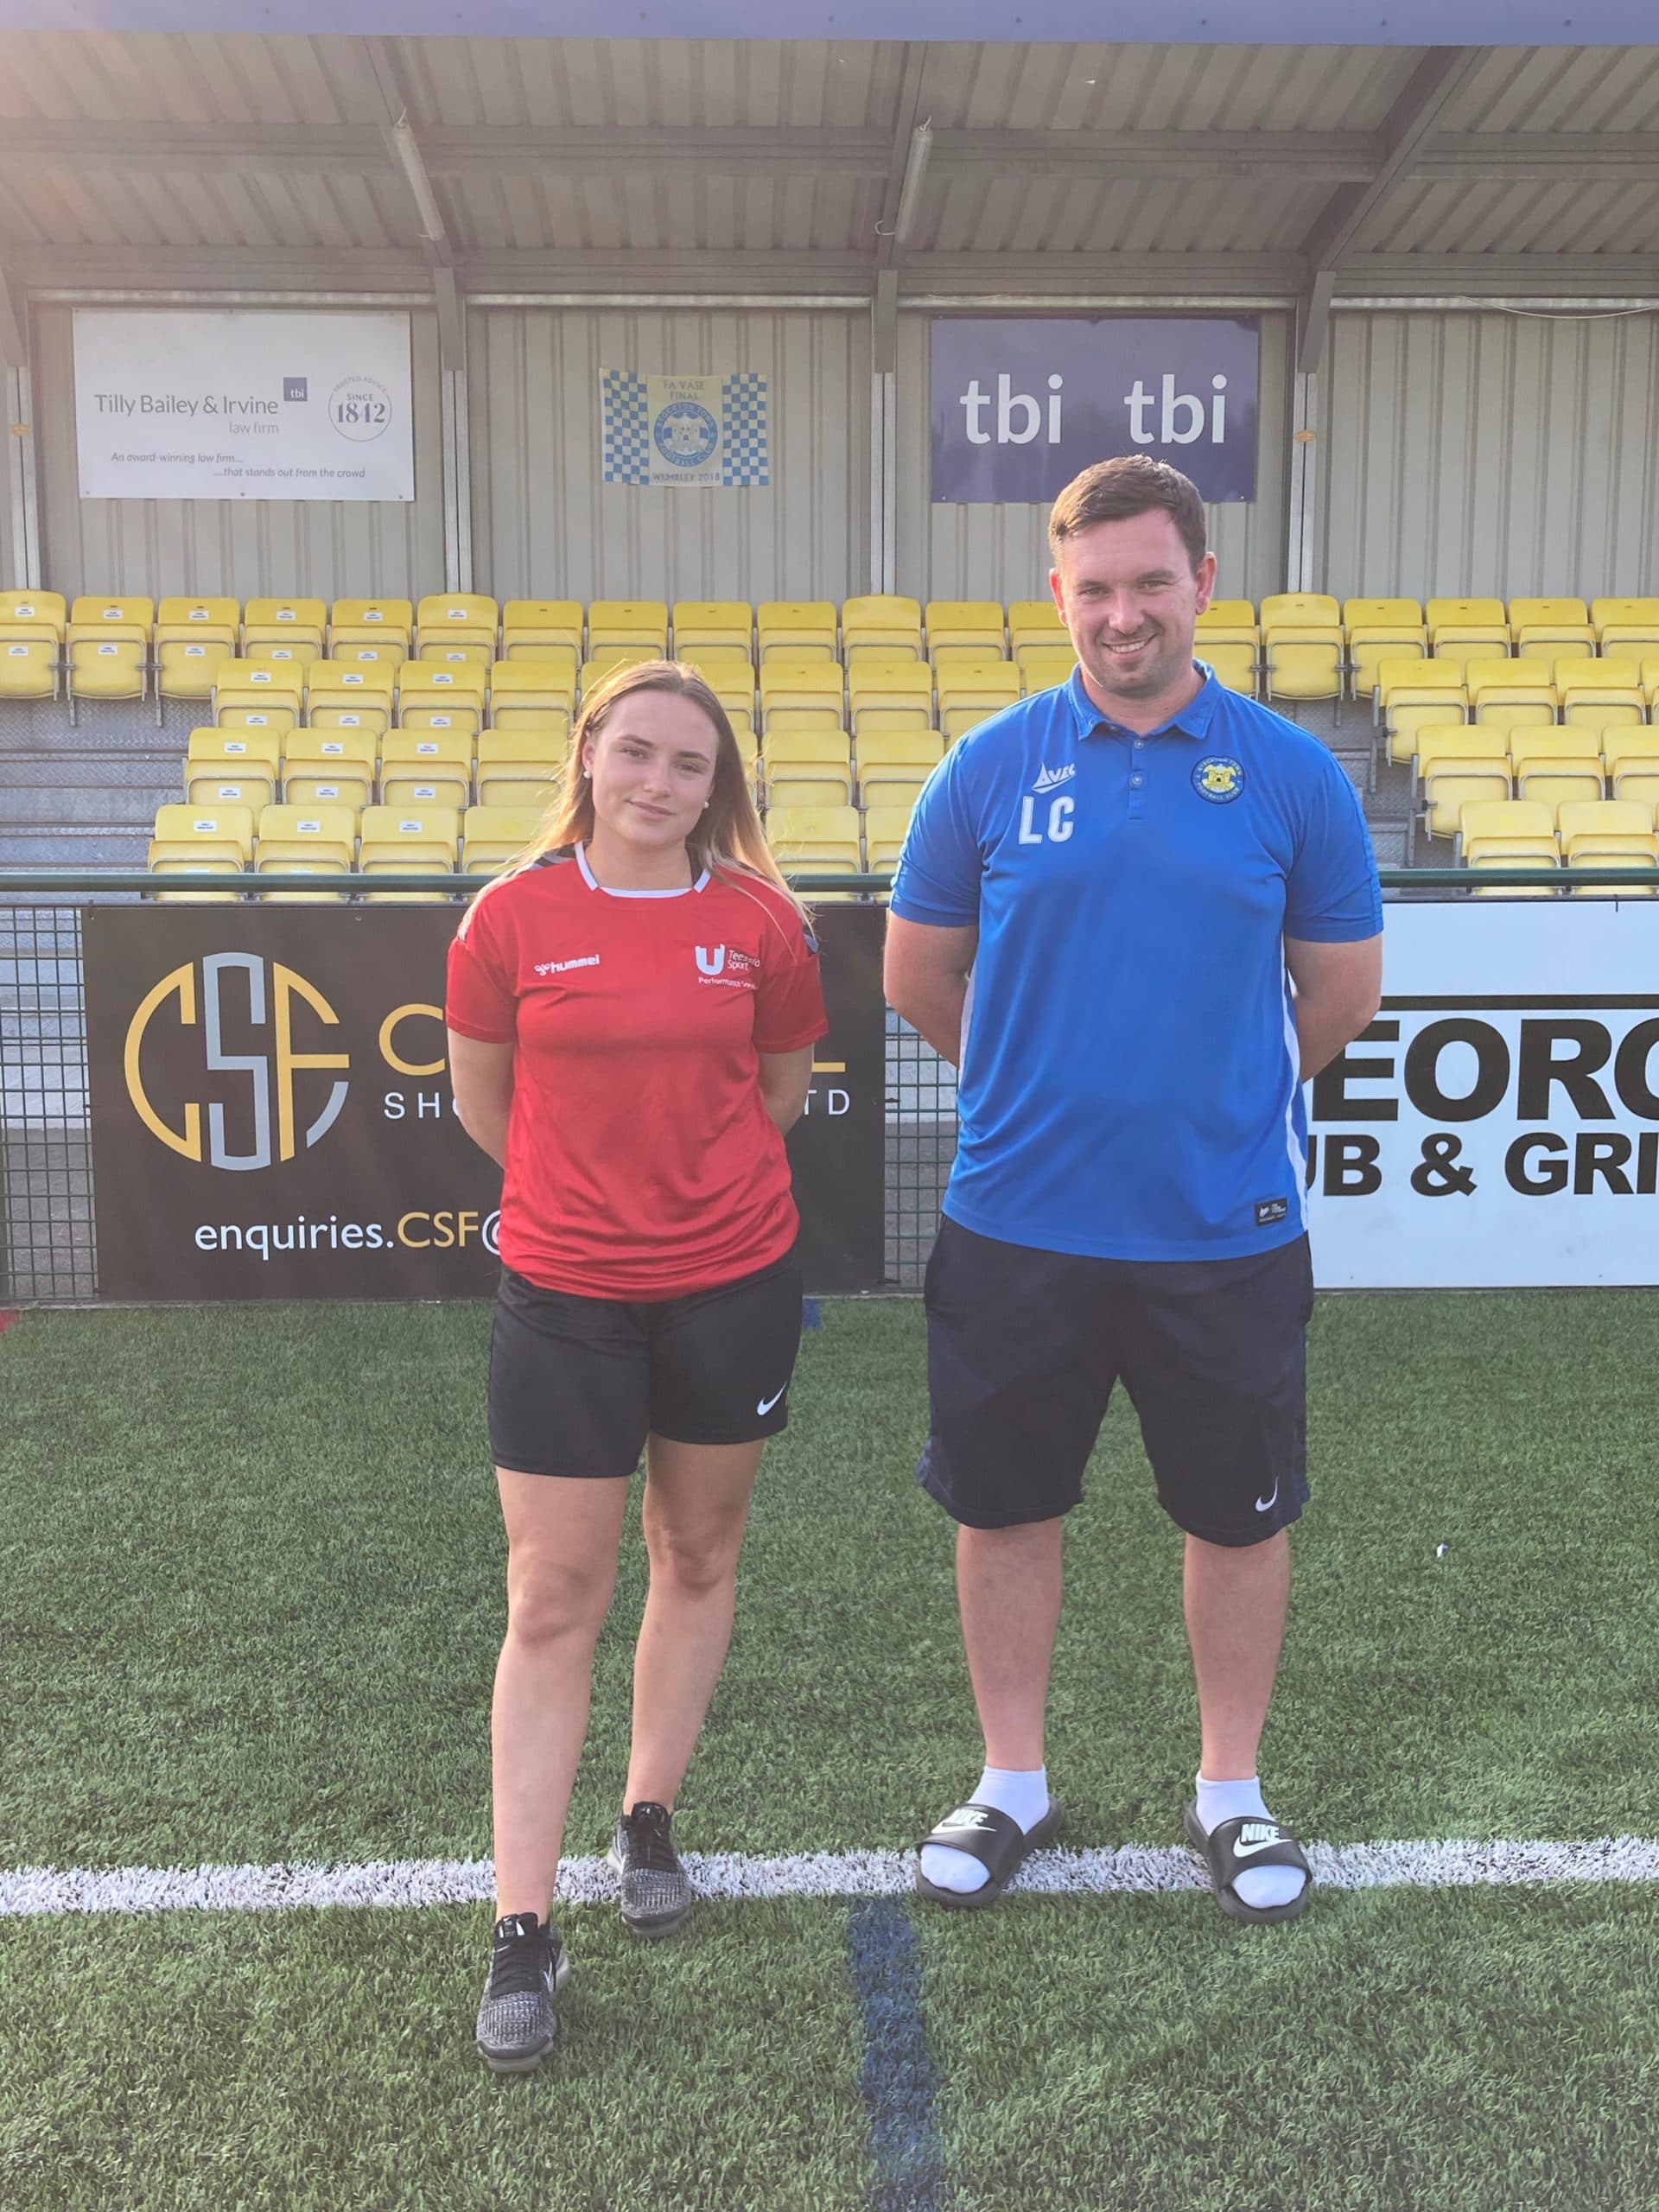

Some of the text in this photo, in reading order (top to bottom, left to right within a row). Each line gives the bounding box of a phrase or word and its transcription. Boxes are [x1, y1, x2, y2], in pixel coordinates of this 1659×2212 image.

[290, 389, 305, 398] tbi
[670, 391, 698, 401] FINAL
[94, 394, 278, 416] Tilly Bailey & Irvine
[959, 373, 1227, 444] tbi tbi
[229, 422, 279, 434] law firm
[111, 453, 124, 461] An
[127, 453, 195, 464] award-winning
[198, 454, 213, 462] law
[245, 467, 276, 476] stands
[277, 468, 293, 477] out
[296, 467, 318, 478] from
[320, 467, 334, 477] the
[337, 467, 365, 477] crowd
[653, 473, 695, 481] WEMBLEY
[550, 953, 601, 975] hummel
[728, 959, 748, 971] Sport
[124, 951, 350, 1171] CSF
[384, 1092, 460, 1119] SH
[1410, 1132, 1478, 1197] &
[1241, 1823, 1280, 1842] NIKE
